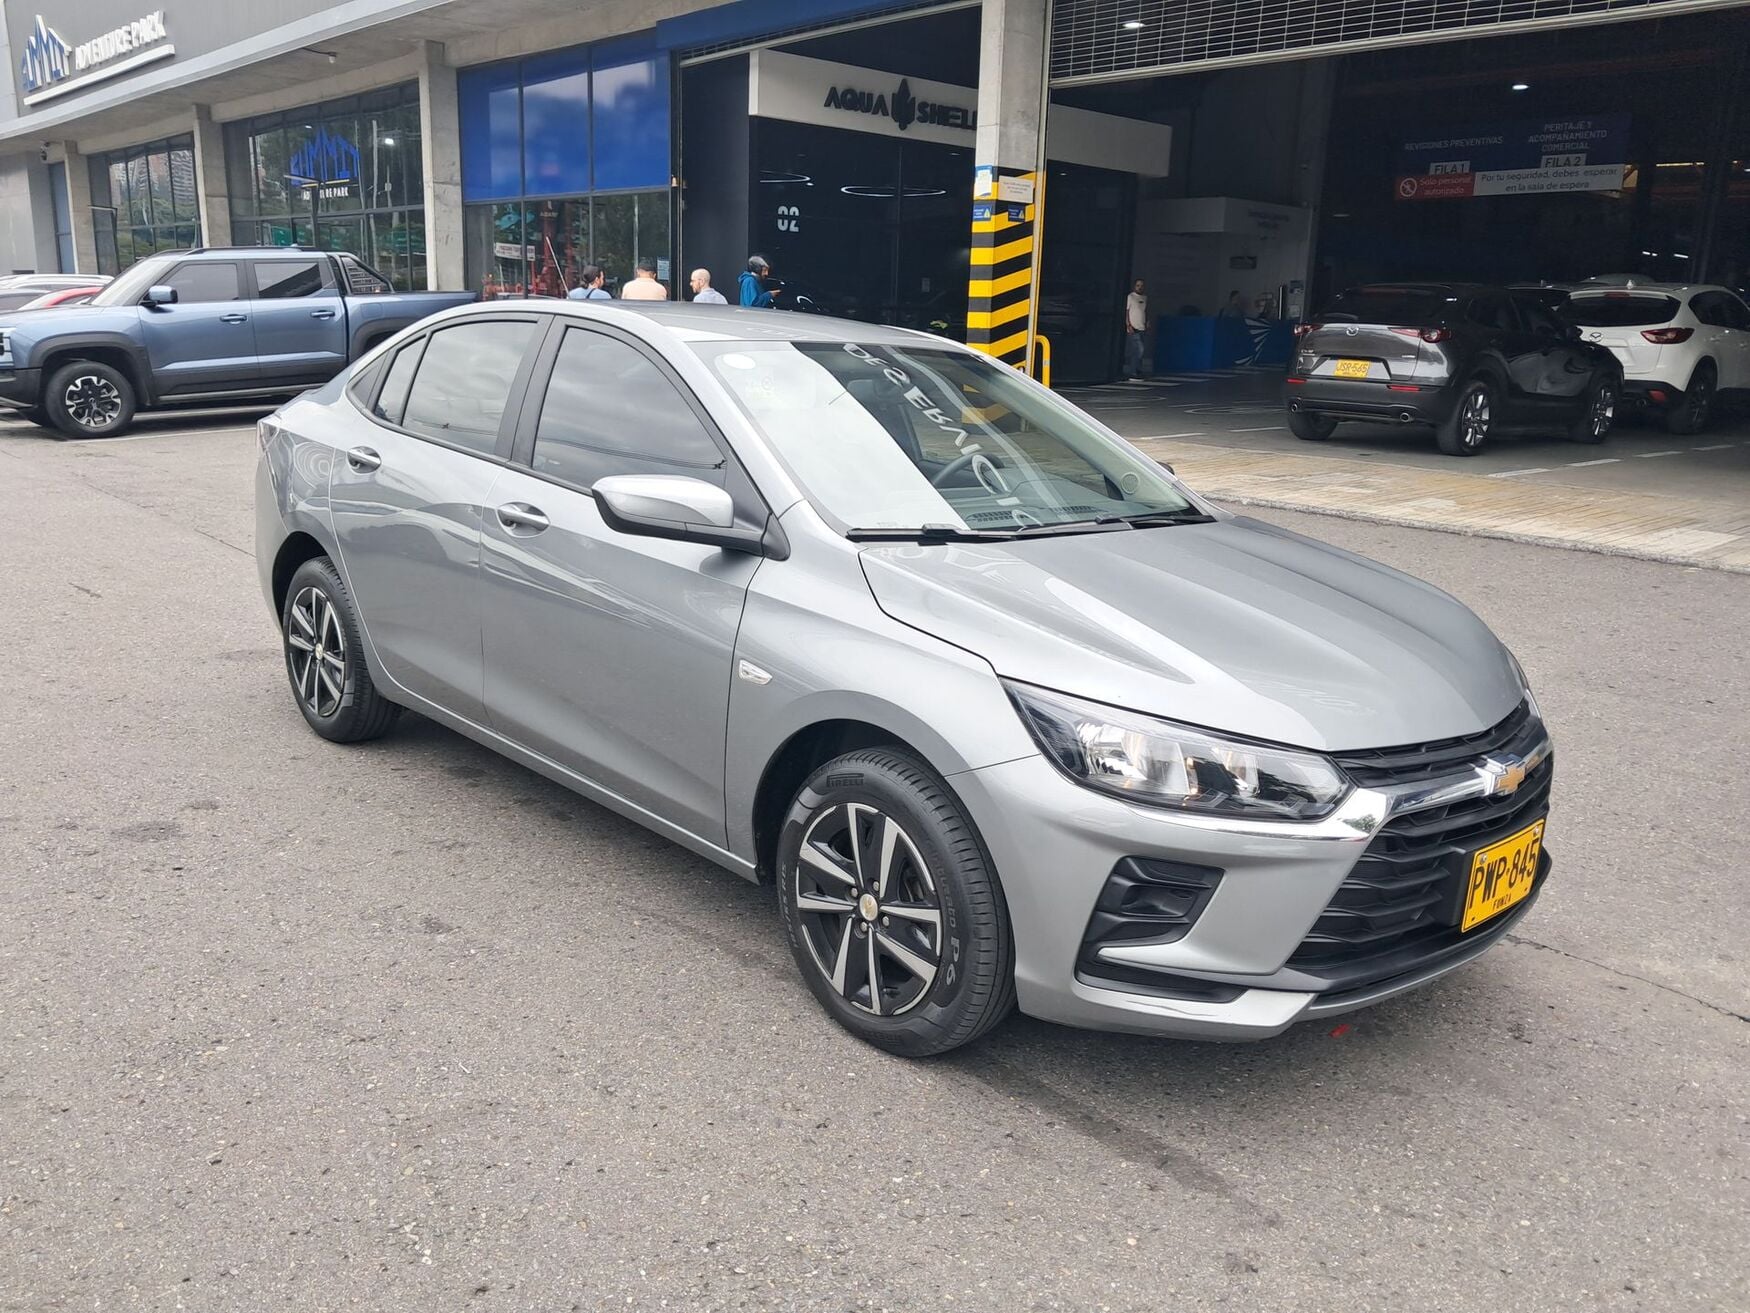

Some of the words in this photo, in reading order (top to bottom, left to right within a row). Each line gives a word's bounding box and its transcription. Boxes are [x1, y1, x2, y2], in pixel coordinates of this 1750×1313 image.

[75, 25, 132, 71] ADVENTURE
[131, 10, 167, 48] PARK
[824, 86, 889, 117] AQUA
[1544, 121, 1584, 132] PERITAJE
[1404, 138, 1450, 150] REVISIONES
[1451, 135, 1504, 147] PREVENTIVAS
[1528, 130, 1608, 143] ACOMPAÑAMIENTO
[1541, 142, 1591, 152] COMERCIAL
[1545, 157, 1569, 167] FILA
[1571, 157, 1581, 167] 2
[1434, 164, 1458, 174] FILA
[1481, 174, 1494, 182] Por
[1496, 173, 1505, 182] tu
[1552, 168, 1579, 178] debes
[1583, 168, 1618, 178] esperar
[333, 186, 349, 198] PARK
[1505, 185, 1517, 193] en
[1527, 182, 1545, 192] sala
[1547, 181, 1559, 191] de
[1560, 180, 1590, 192] espera
[777, 205, 800, 232] 02
[826, 772, 865, 787] PIRELLI
[1492, 893, 1512, 911] FUNZA
